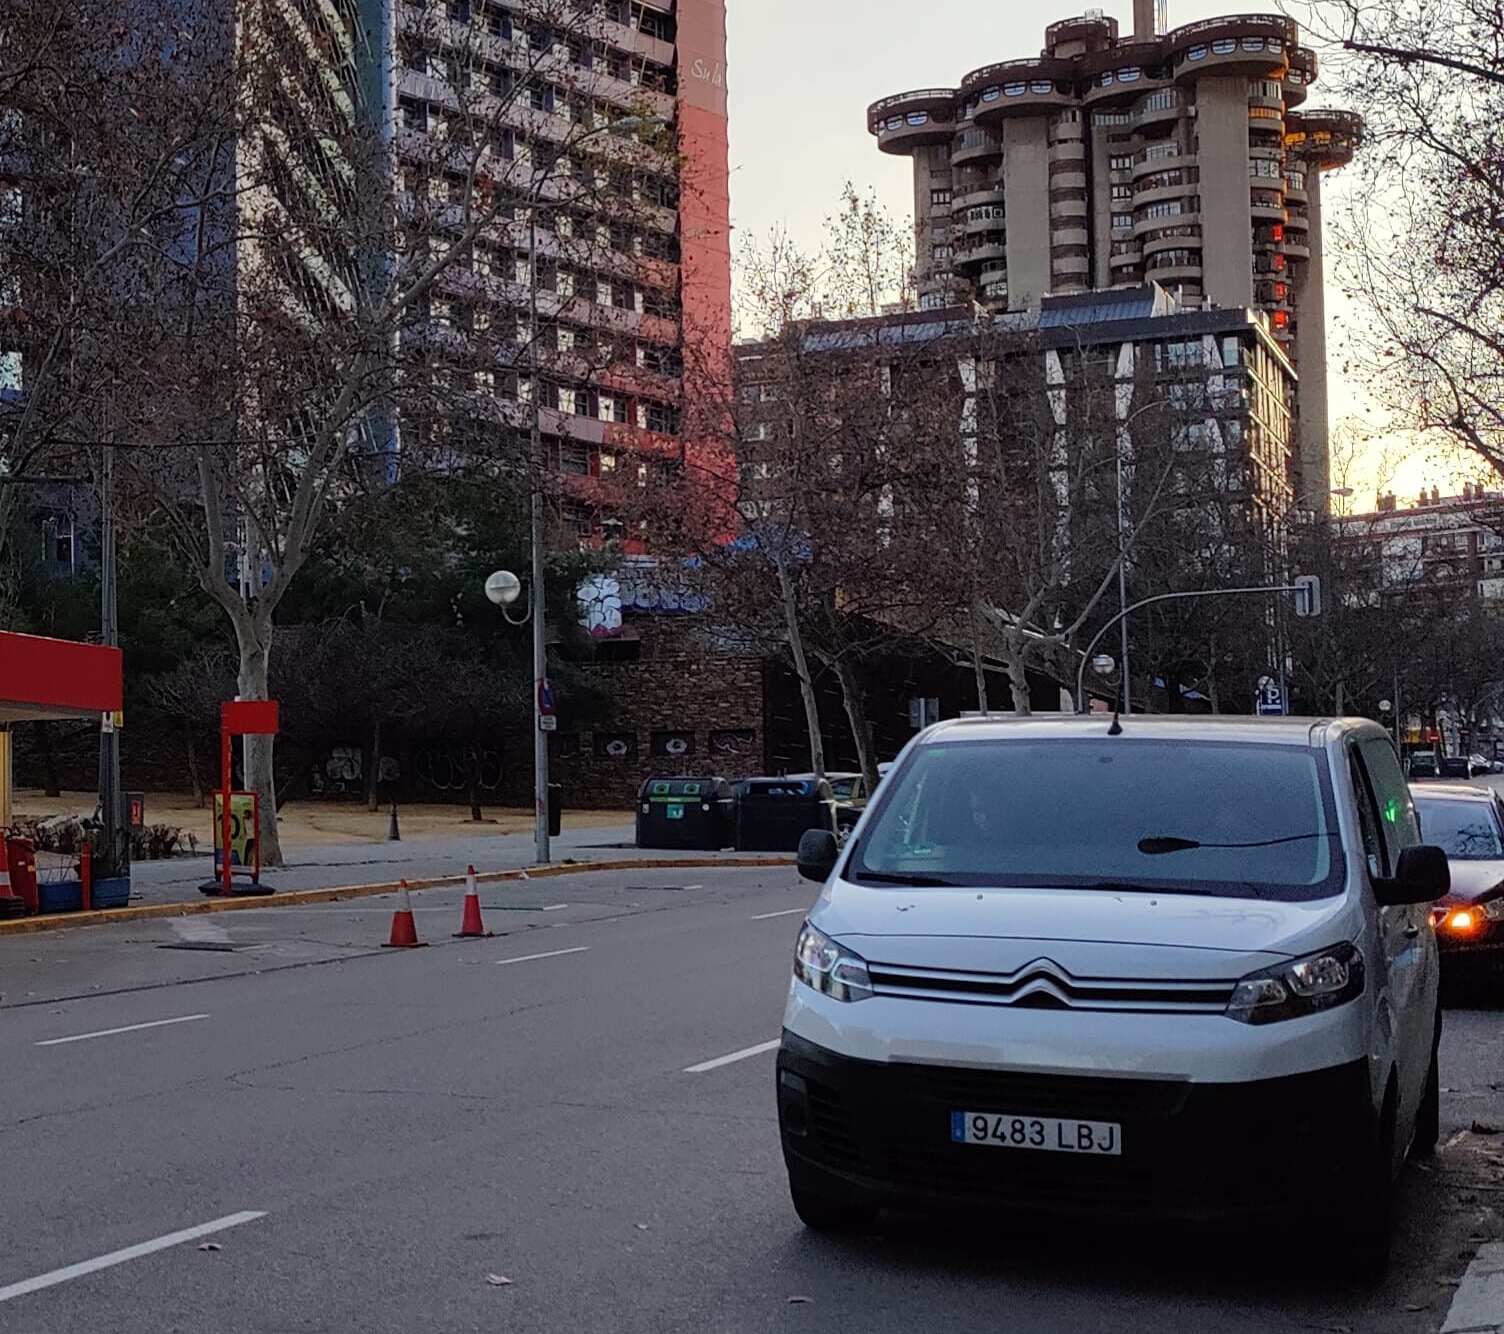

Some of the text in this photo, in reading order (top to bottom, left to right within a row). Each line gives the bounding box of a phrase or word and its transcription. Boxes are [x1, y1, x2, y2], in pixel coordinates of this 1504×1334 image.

[1267, 688, 1280, 704] P
[972, 1115, 1114, 1152] 9483 LBJ
